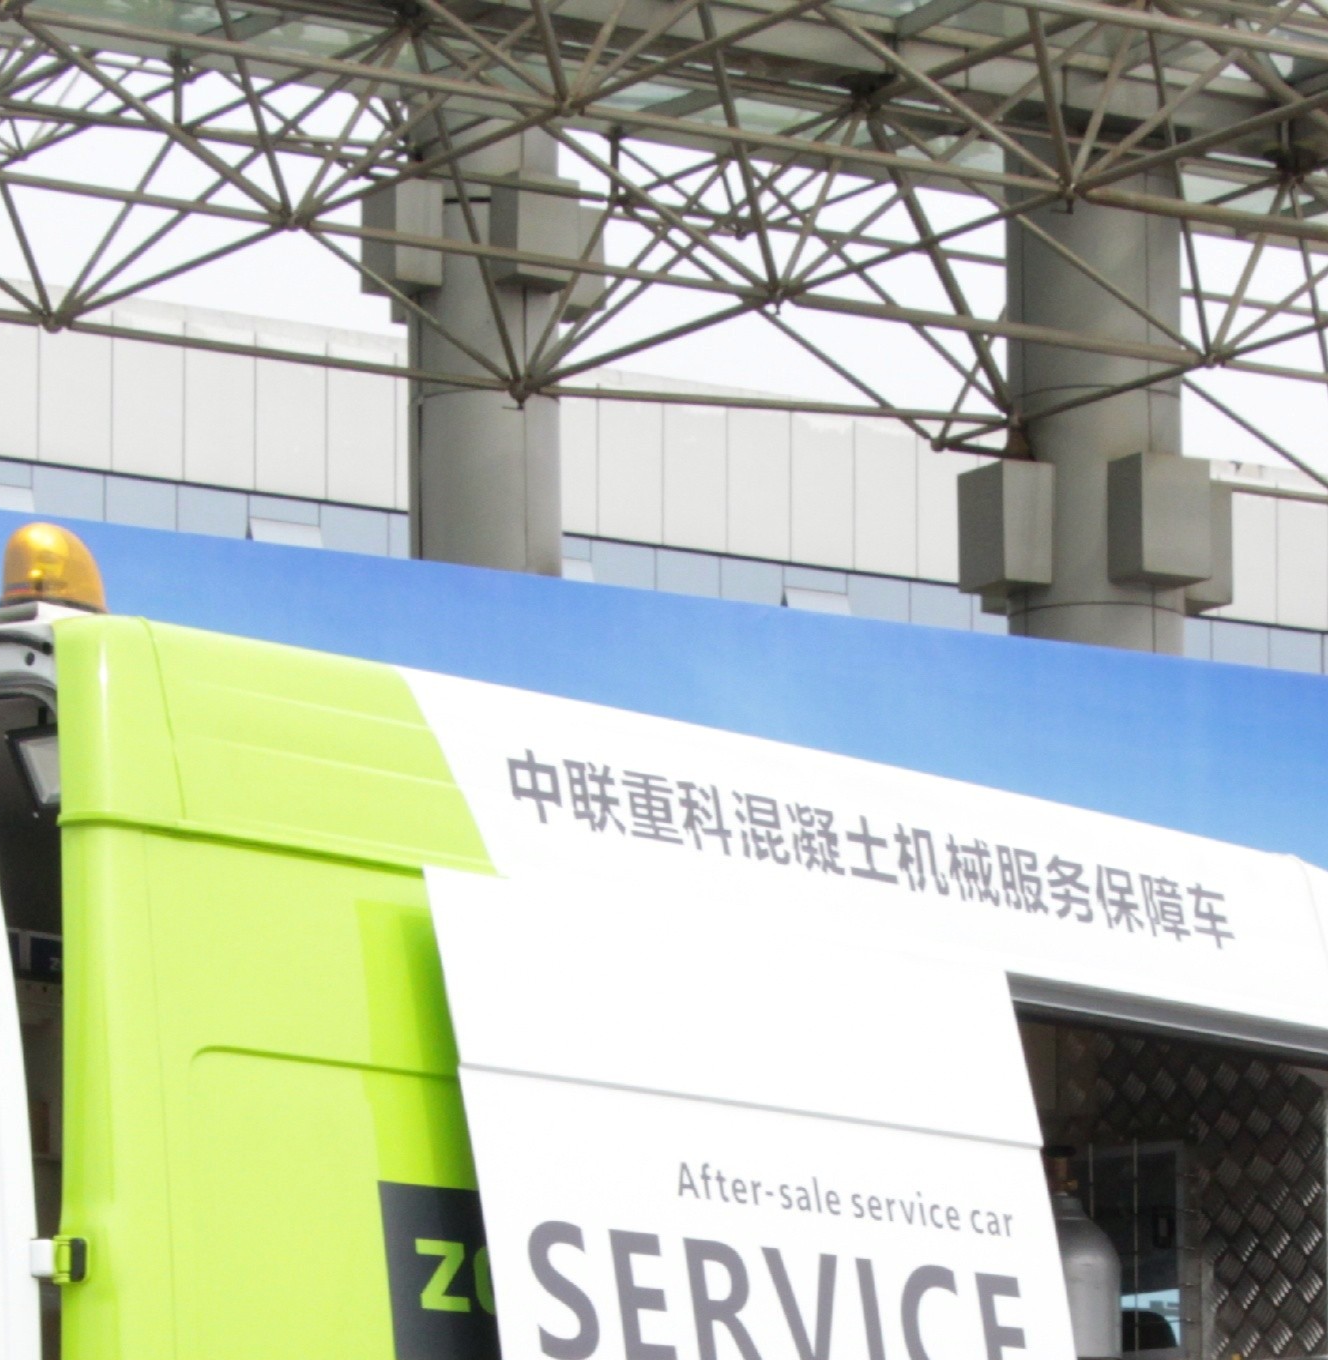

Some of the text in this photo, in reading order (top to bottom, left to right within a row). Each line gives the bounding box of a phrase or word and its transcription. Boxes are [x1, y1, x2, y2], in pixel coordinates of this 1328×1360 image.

[506, 748, 1235, 949] 中联重科混凝土机械服务保障车
[678, 1161, 1014, 1238] After-sale service car
